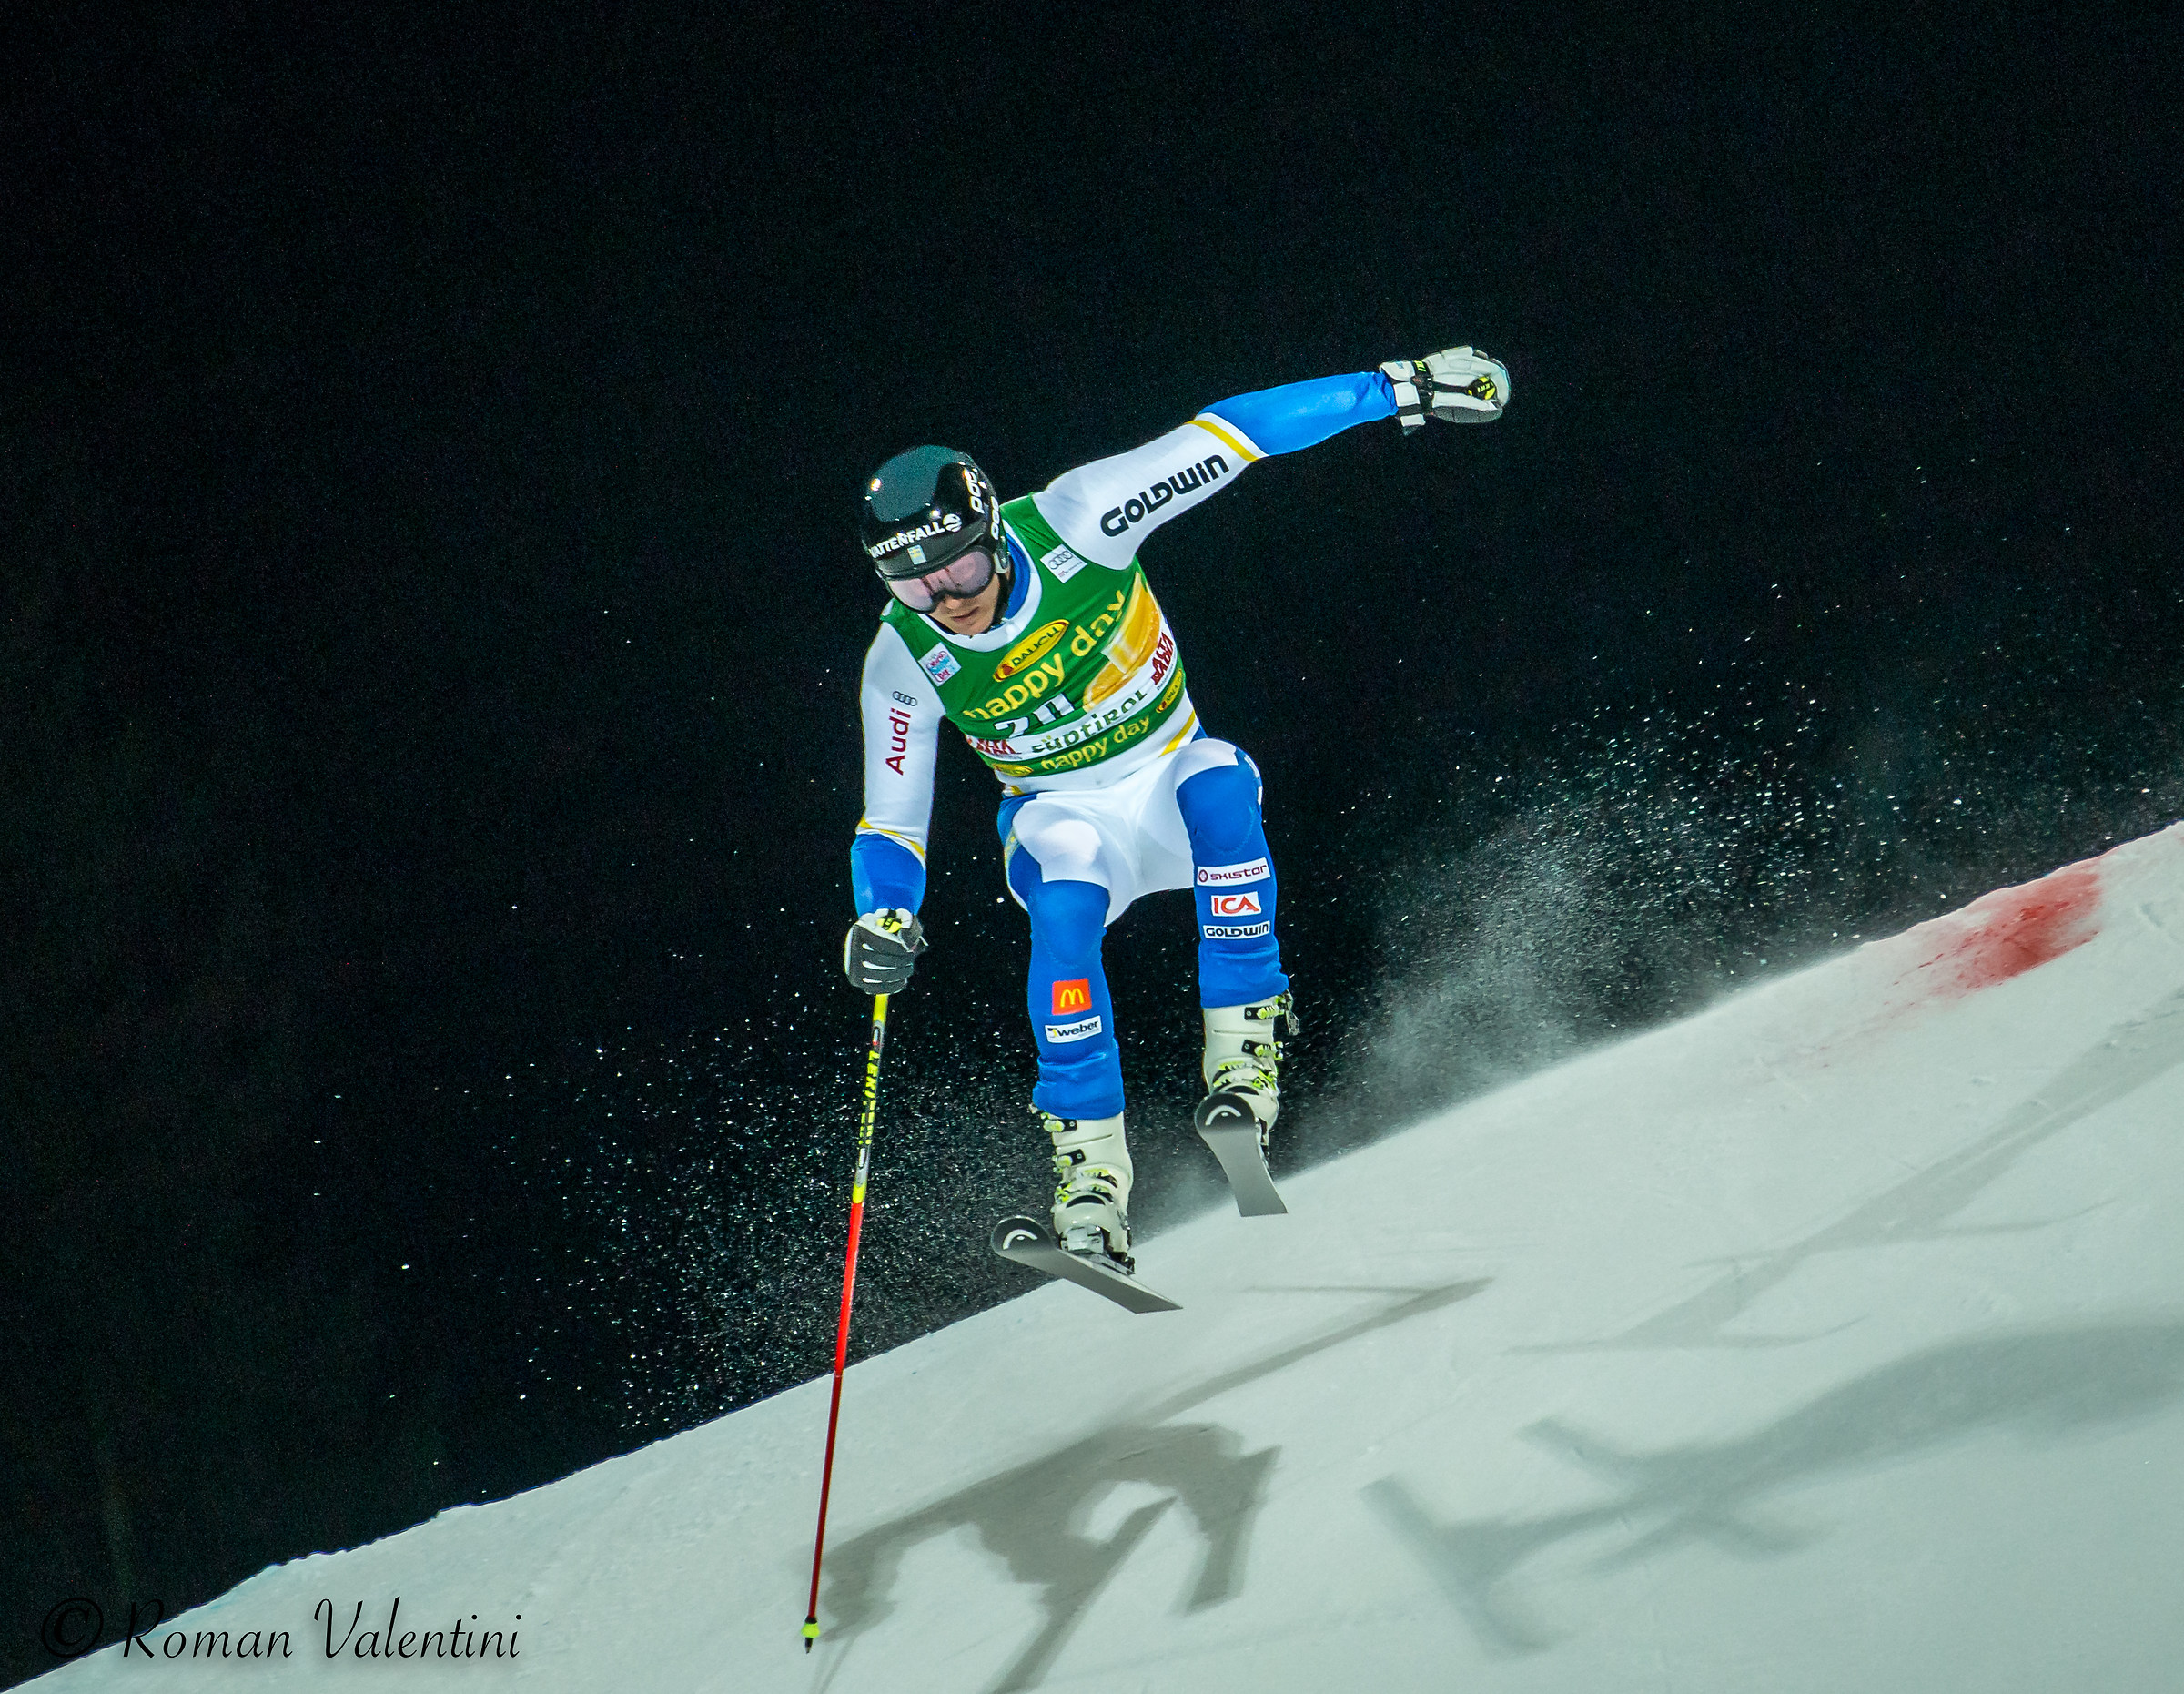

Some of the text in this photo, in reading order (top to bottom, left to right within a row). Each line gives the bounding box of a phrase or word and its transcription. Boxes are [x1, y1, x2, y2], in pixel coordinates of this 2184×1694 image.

[1071, 589, 1126, 657] day
[885, 706, 912, 776] Audi
[1112, 715, 1150, 744] day
[1213, 895, 1260, 915] ICA
[1057, 1019, 1099, 1037] weber
